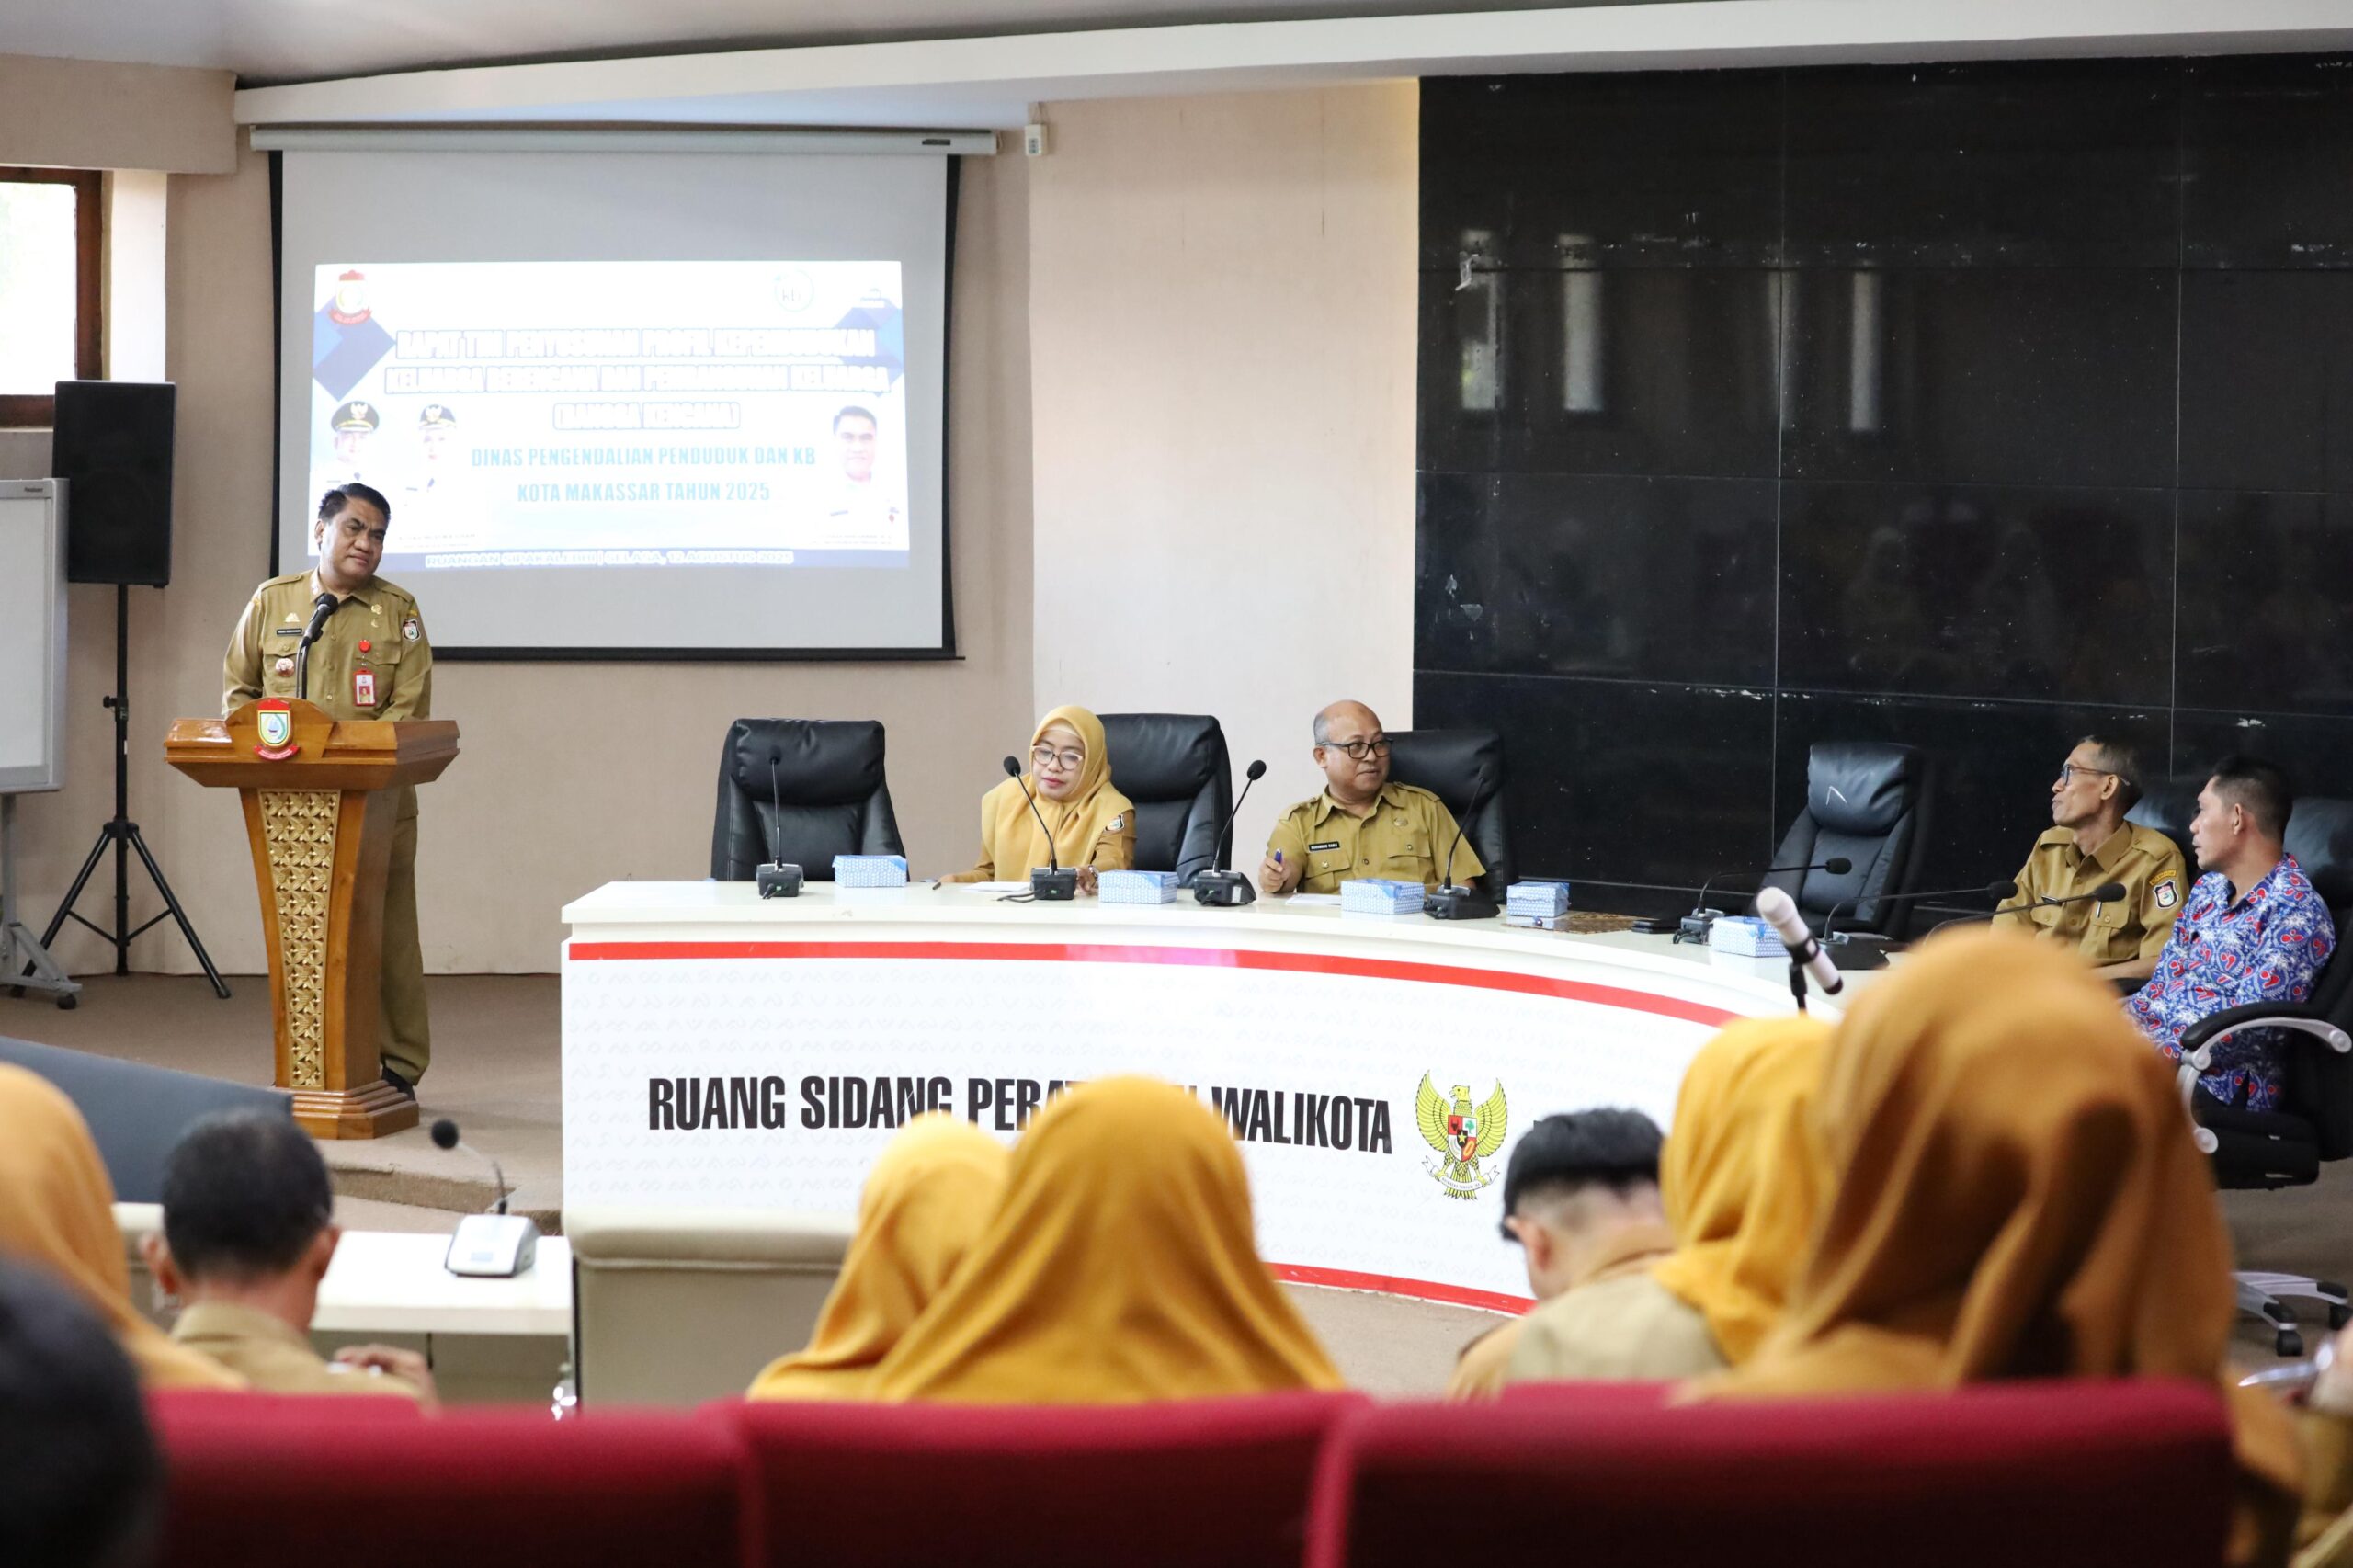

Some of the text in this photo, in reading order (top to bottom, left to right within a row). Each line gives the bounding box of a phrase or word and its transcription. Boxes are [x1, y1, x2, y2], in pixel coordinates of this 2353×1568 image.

[471, 446, 817, 466] DINAS PENGENDALIAN PENDUDUK DAN KB
[517, 482, 770, 502] KOTA MAKASSAR TAHUN 2025
[426, 553, 500, 568] RUANGAN
[688, 551, 756, 564] AGUSTUS
[757, 551, 793, 564] 2025
[649, 1076, 786, 1130] RUANG
[801, 1076, 953, 1129] SIDANG
[1211, 1086, 1392, 1154] WALIKOTA
